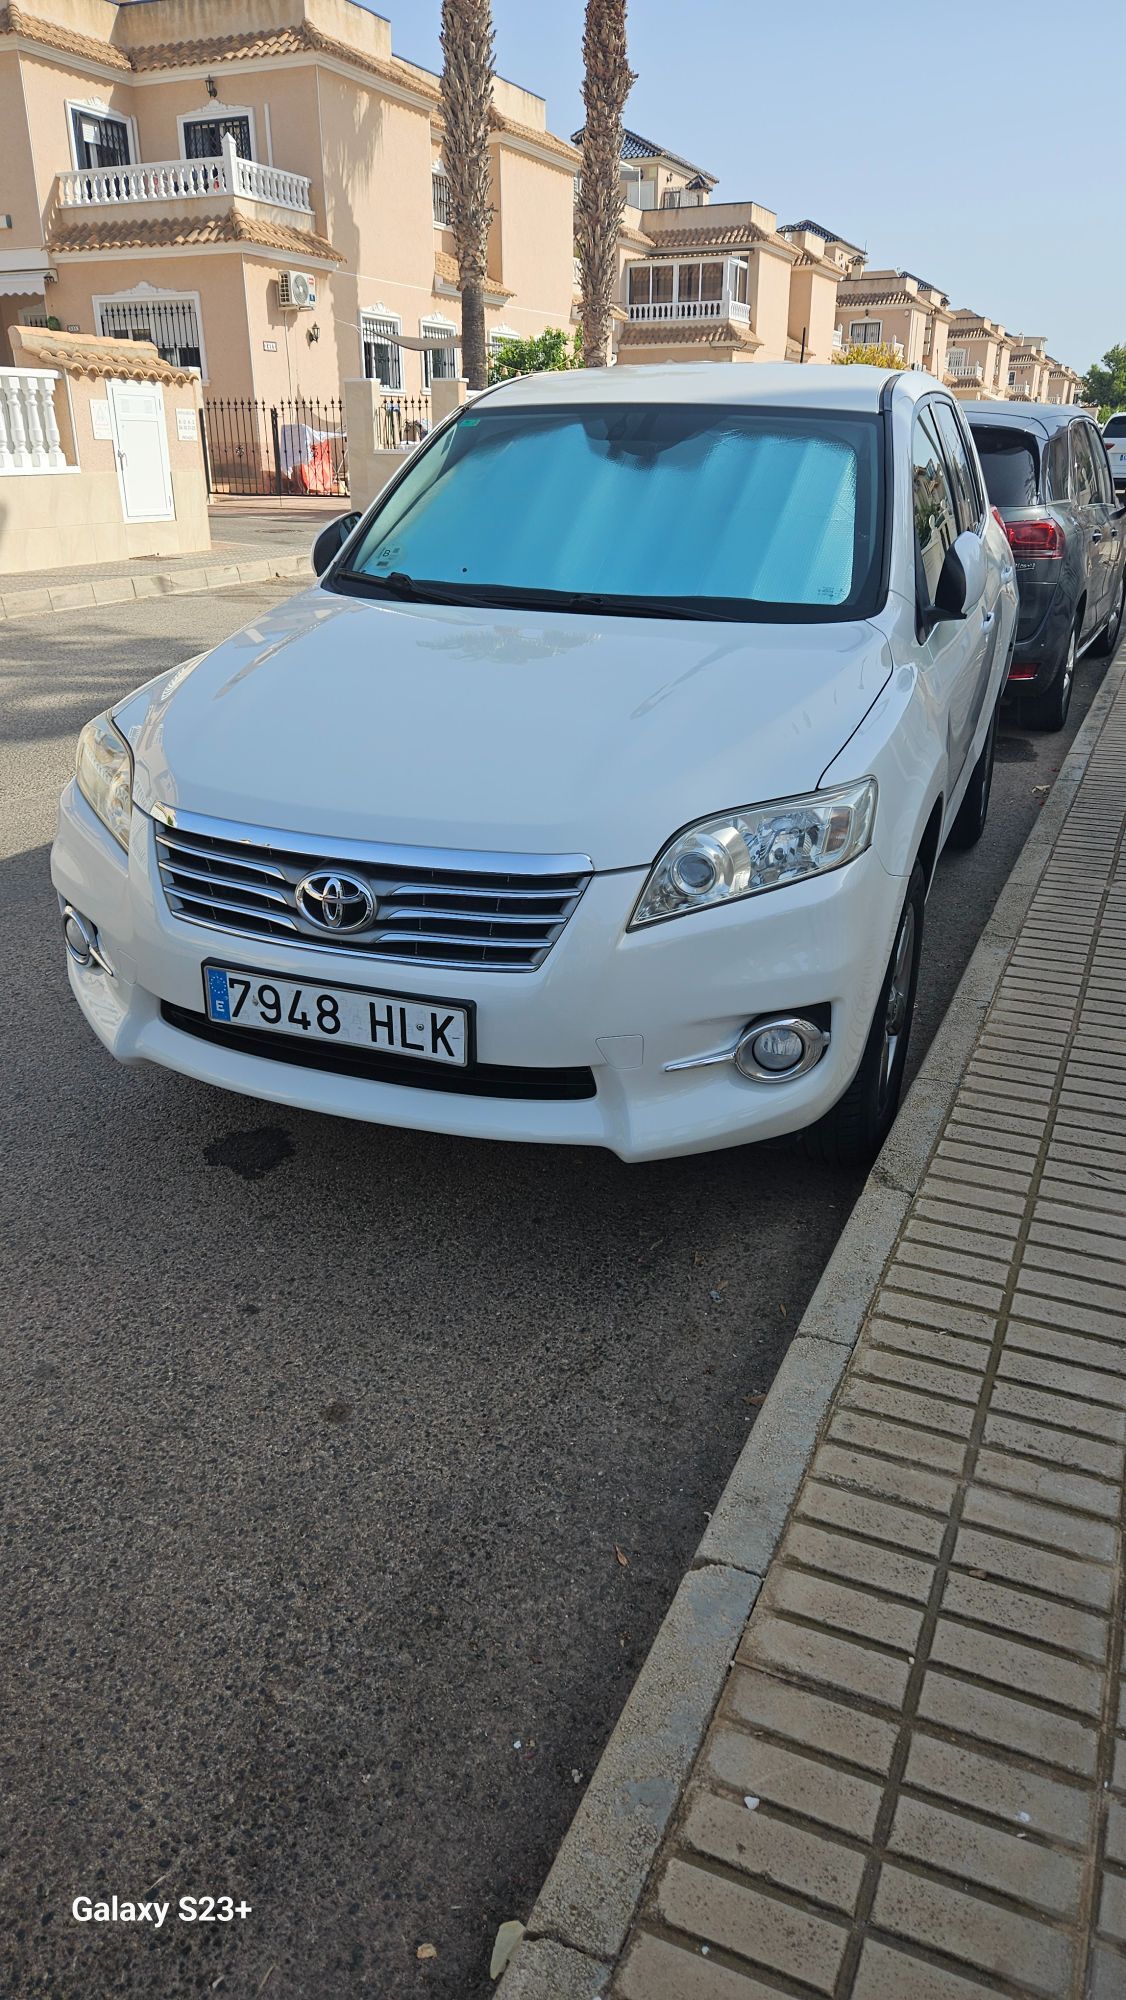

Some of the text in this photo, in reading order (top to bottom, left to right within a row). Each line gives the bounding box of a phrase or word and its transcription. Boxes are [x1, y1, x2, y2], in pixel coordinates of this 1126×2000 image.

[216, 1000, 224, 1011] E
[229, 977, 455, 1057] 7948 HLK
